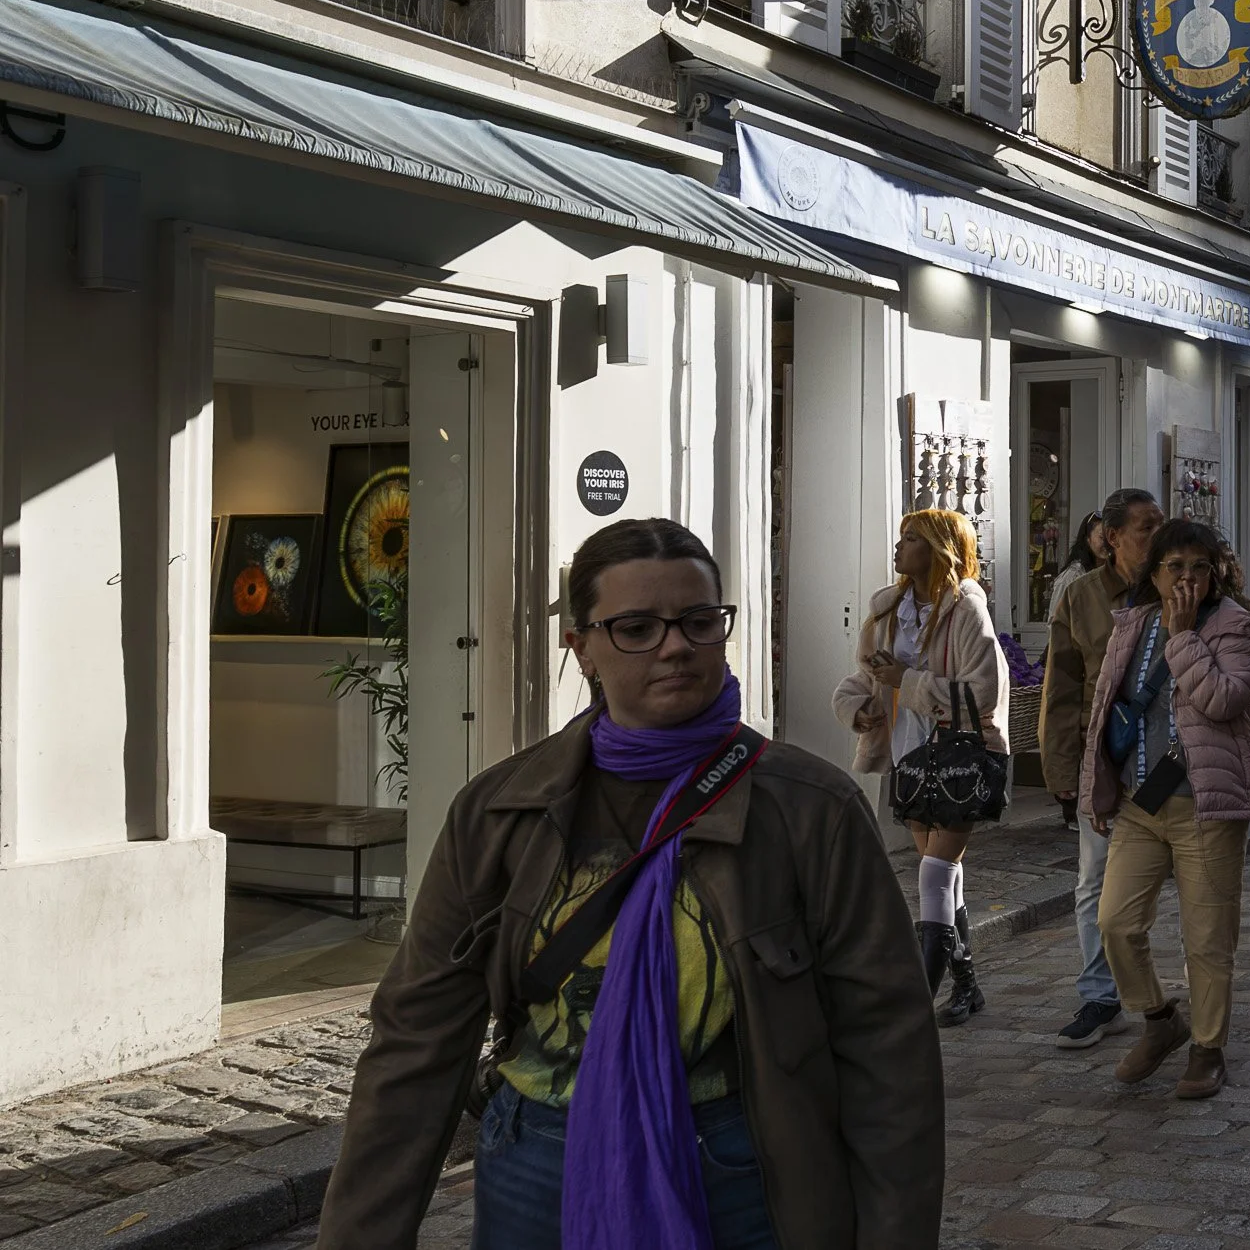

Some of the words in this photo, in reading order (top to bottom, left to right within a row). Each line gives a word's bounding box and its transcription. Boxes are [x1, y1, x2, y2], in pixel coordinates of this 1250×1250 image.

[786, 191, 811, 206] NATURE
[921, 206, 955, 245] LA
[964, 220, 1106, 291] SAVONNERIE
[1111, 266, 1135, 298] DE
[1141, 276, 1250, 330] MONTMARTRE
[311, 415, 350, 431] YOUR
[353, 413, 378, 429] EYE
[583, 468, 625, 479] DISCOVER
[584, 478, 608, 488] YOUR
[609, 479, 625, 489] IRIS
[587, 492, 603, 501] FREE
[604, 492, 622, 501] TRIAL
[697, 744, 748, 794] Canon
